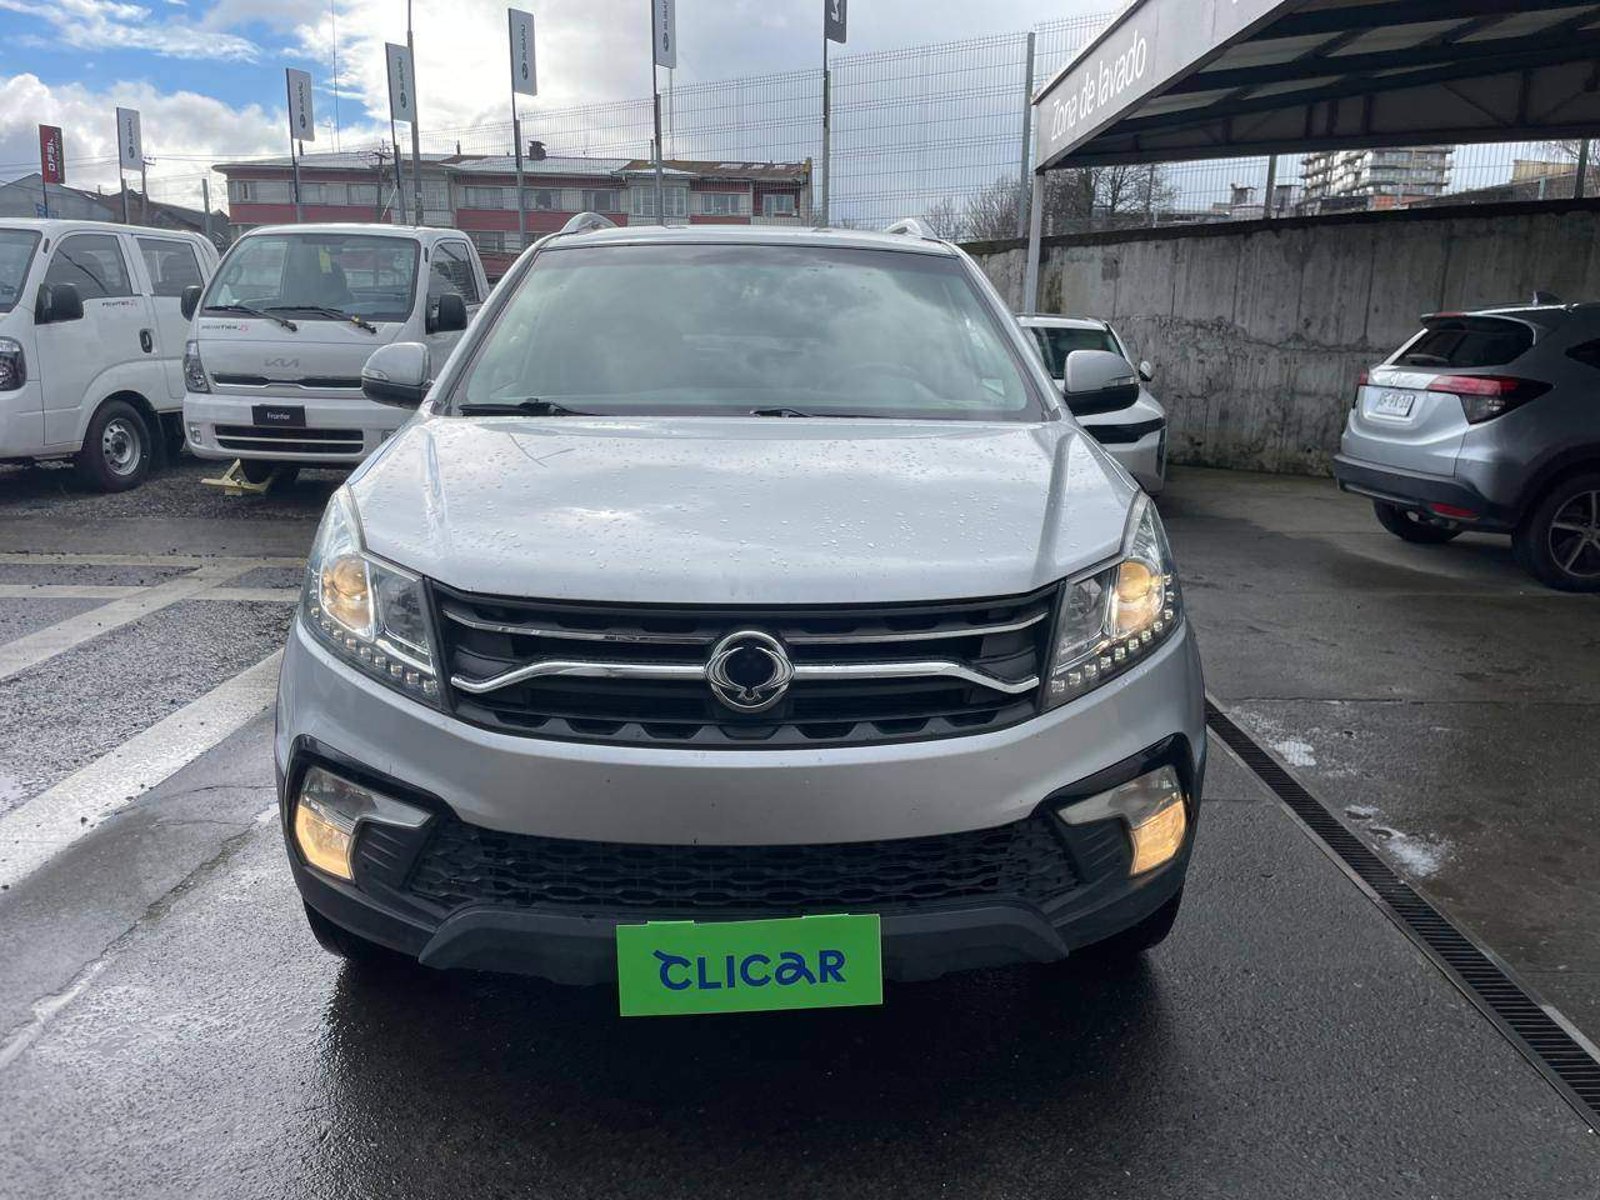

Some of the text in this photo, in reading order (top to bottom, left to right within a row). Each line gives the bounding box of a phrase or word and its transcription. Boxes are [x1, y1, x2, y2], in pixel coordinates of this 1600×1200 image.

[1051, 30, 1147, 141] Zona de lavado
[266, 411, 291, 420] Frontier
